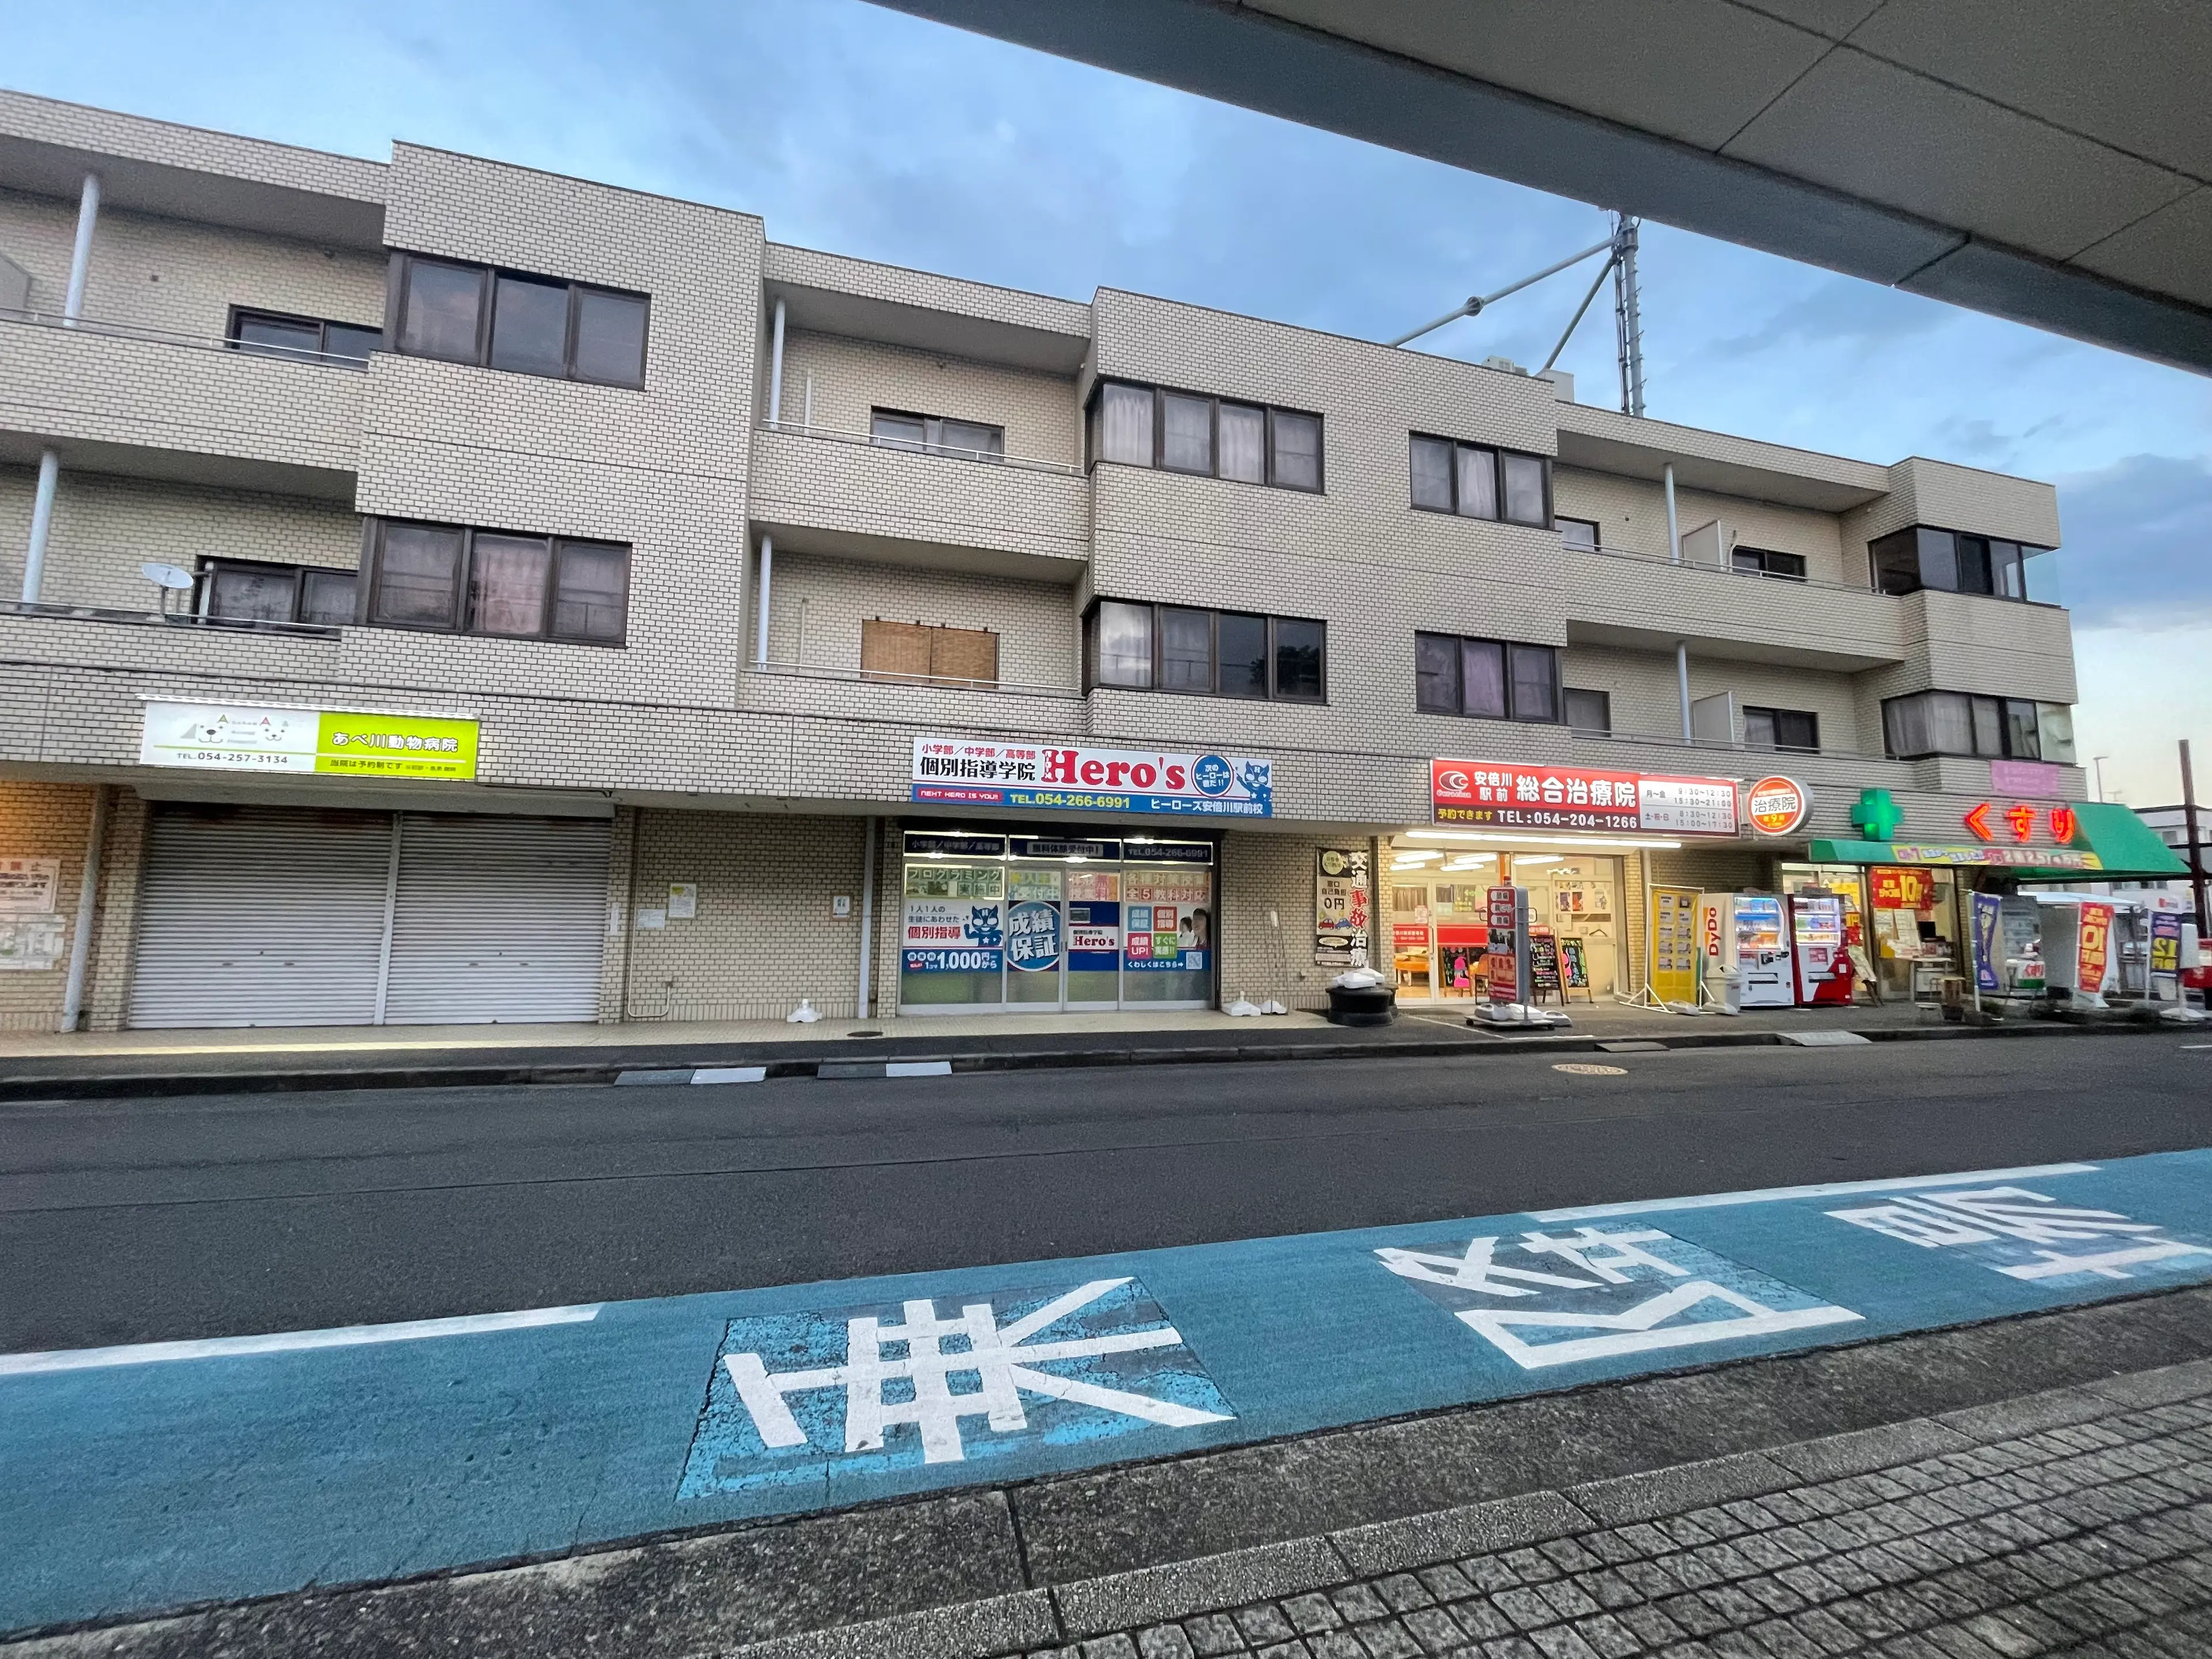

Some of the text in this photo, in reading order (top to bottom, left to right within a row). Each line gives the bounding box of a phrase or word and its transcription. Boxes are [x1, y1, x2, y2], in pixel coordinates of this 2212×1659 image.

[332, 732, 458, 752] あべ川動物病院
[920, 756, 1036, 781] 個別指導学院
[1041, 749, 1185, 790] Hero's
[1205, 764, 1219, 772] 次の
[1474, 771, 1513, 787] 安倍川
[1479, 787, 1509, 802] 駅前
[1516, 775, 1637, 808] 総合治療院
[1010, 793, 1130, 809] TEL.054-266-6991
[1151, 799, 1263, 814] ヒーローズ安倍川駅前校
[1754, 796, 1796, 813] 治療院
[1438, 808, 1493, 821] 予約できます
[1498, 810, 1638, 829] TEL:054-204-1266
[1964, 801, 2075, 844] くすり
[908, 869, 999, 880] プログラミング
[1324, 897, 1345, 910] 0円
[1349, 851, 1369, 967] 交通事故治療
[1009, 909, 1055, 937] 成績
[908, 926, 961, 940] 個別指導
[1073, 935, 1115, 946] Hero's
[1011, 933, 1058, 961] 保証
